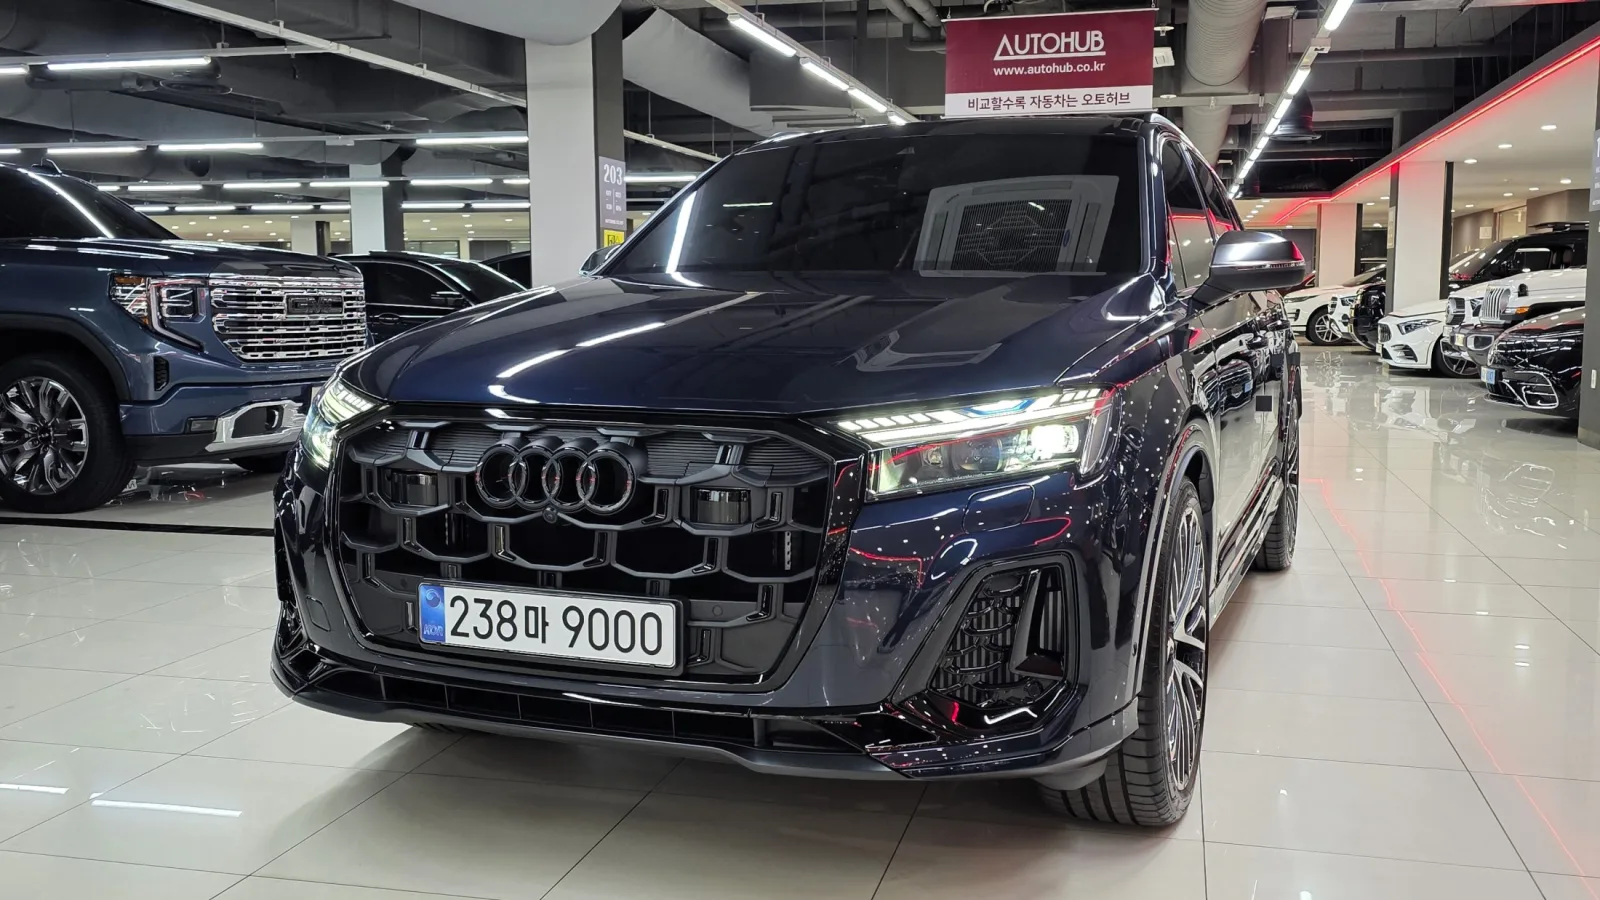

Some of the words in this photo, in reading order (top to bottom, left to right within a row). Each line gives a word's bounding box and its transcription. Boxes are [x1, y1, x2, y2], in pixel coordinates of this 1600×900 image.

[993, 30, 1106, 61] AUTOHUB
[993, 61, 1106, 76] www.autohub.co.kr
[967, 95, 1027, 112] 비교할수록
[1029, 93, 1078, 109] 자동차는
[1081, 92, 1131, 107] 오토허브
[604, 164, 622, 185] 203
[449, 595, 549, 644] 238마
[561, 605, 662, 656] 9000
